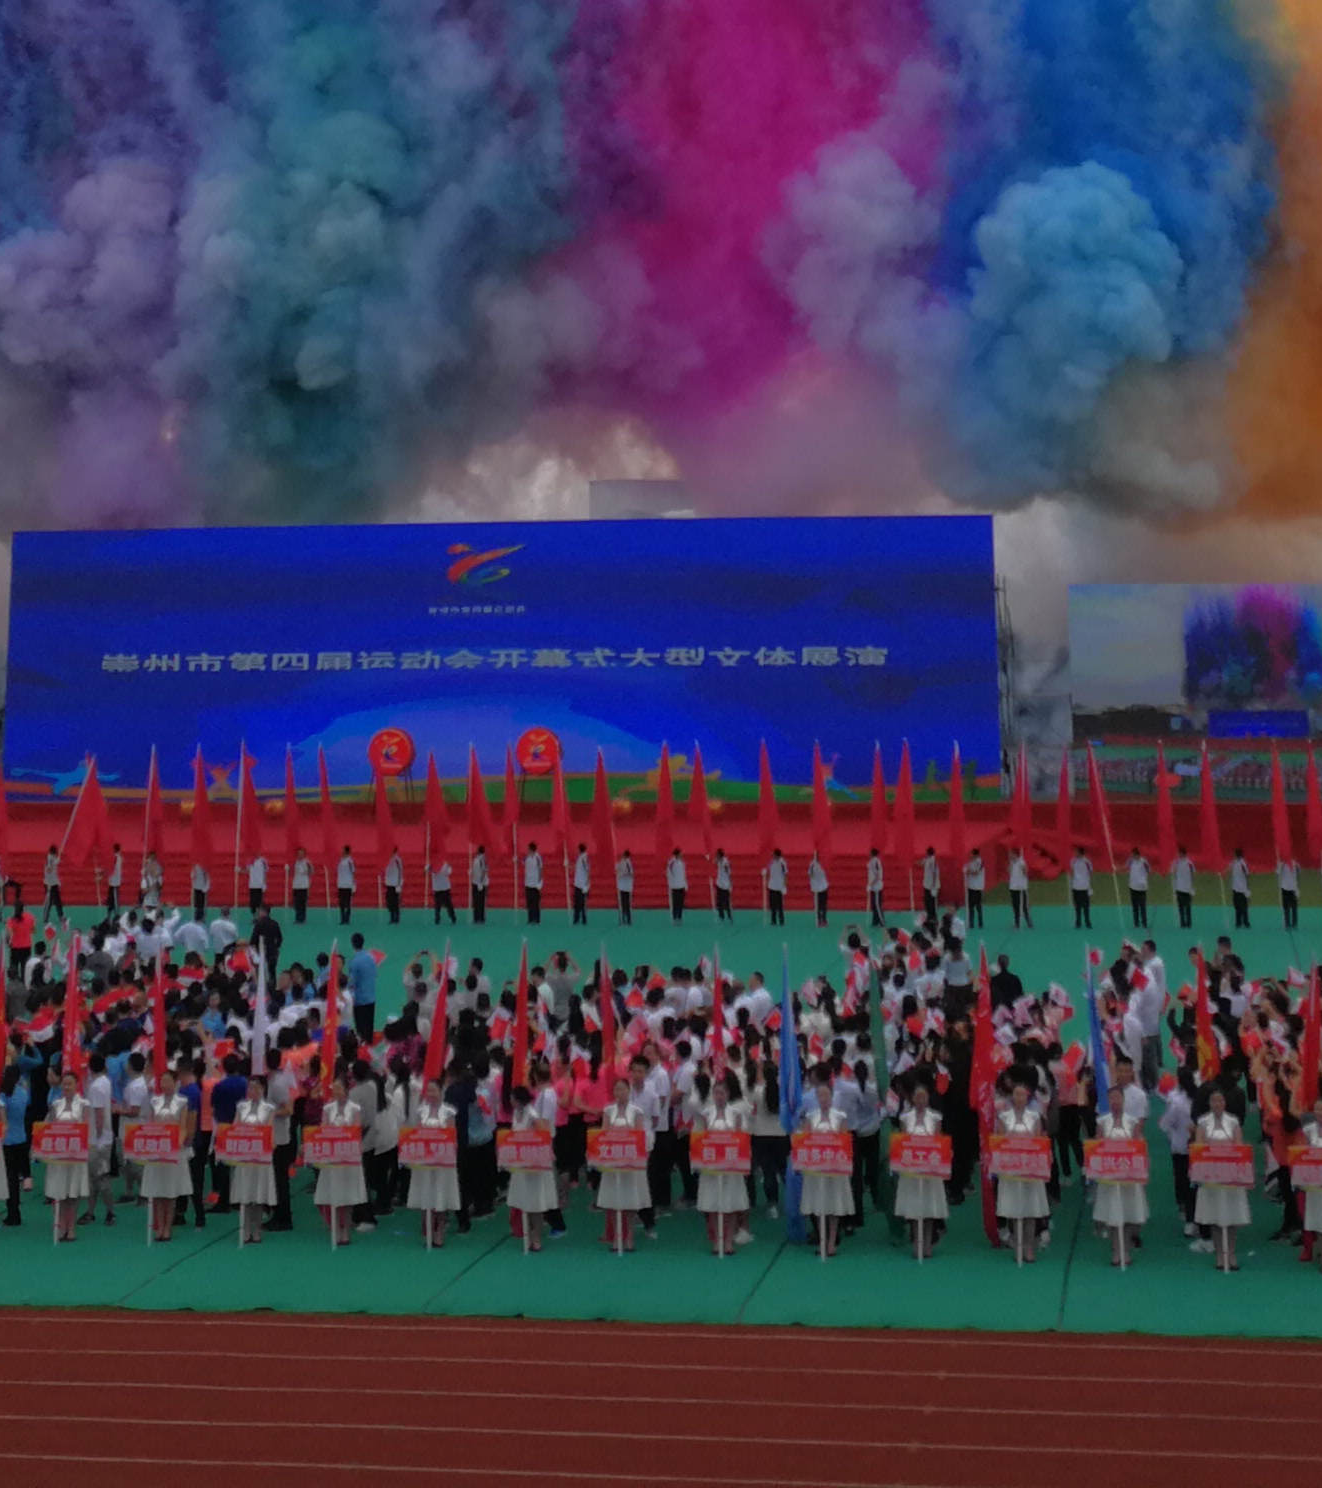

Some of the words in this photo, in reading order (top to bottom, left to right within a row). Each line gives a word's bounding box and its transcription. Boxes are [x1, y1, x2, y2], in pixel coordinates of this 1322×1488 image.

[101, 646, 889, 673] 崇州市第四届运动会开幕式大型文体展演
